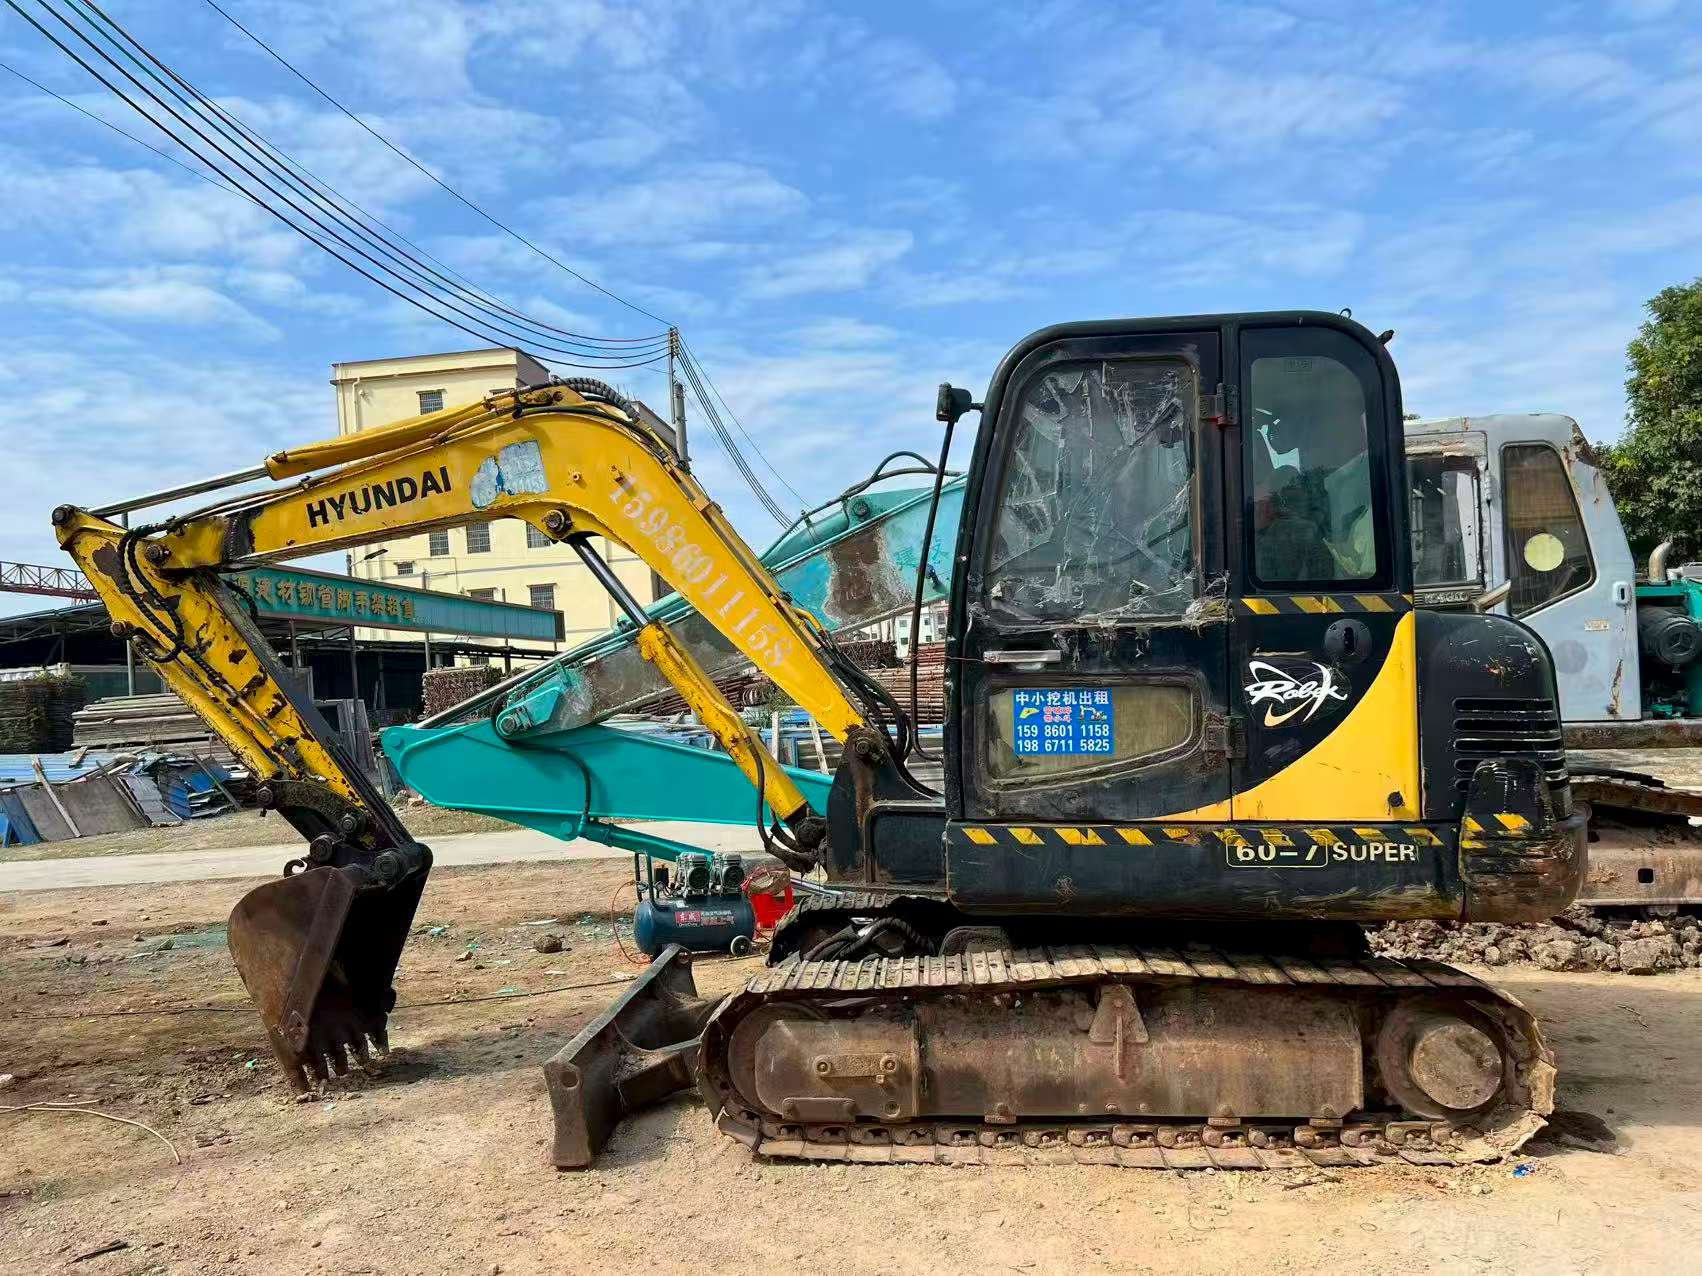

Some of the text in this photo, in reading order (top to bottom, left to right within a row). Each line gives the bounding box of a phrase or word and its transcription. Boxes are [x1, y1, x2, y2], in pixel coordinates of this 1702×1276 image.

[306, 466, 452, 528] HYUNDAI
[1016, 691, 1109, 706] 中小挖机出租
[1017, 724, 1109, 737] 159 8601 1158
[1017, 739, 1109, 752] 198 6711 5825
[1332, 842, 1416, 862] SUPER
